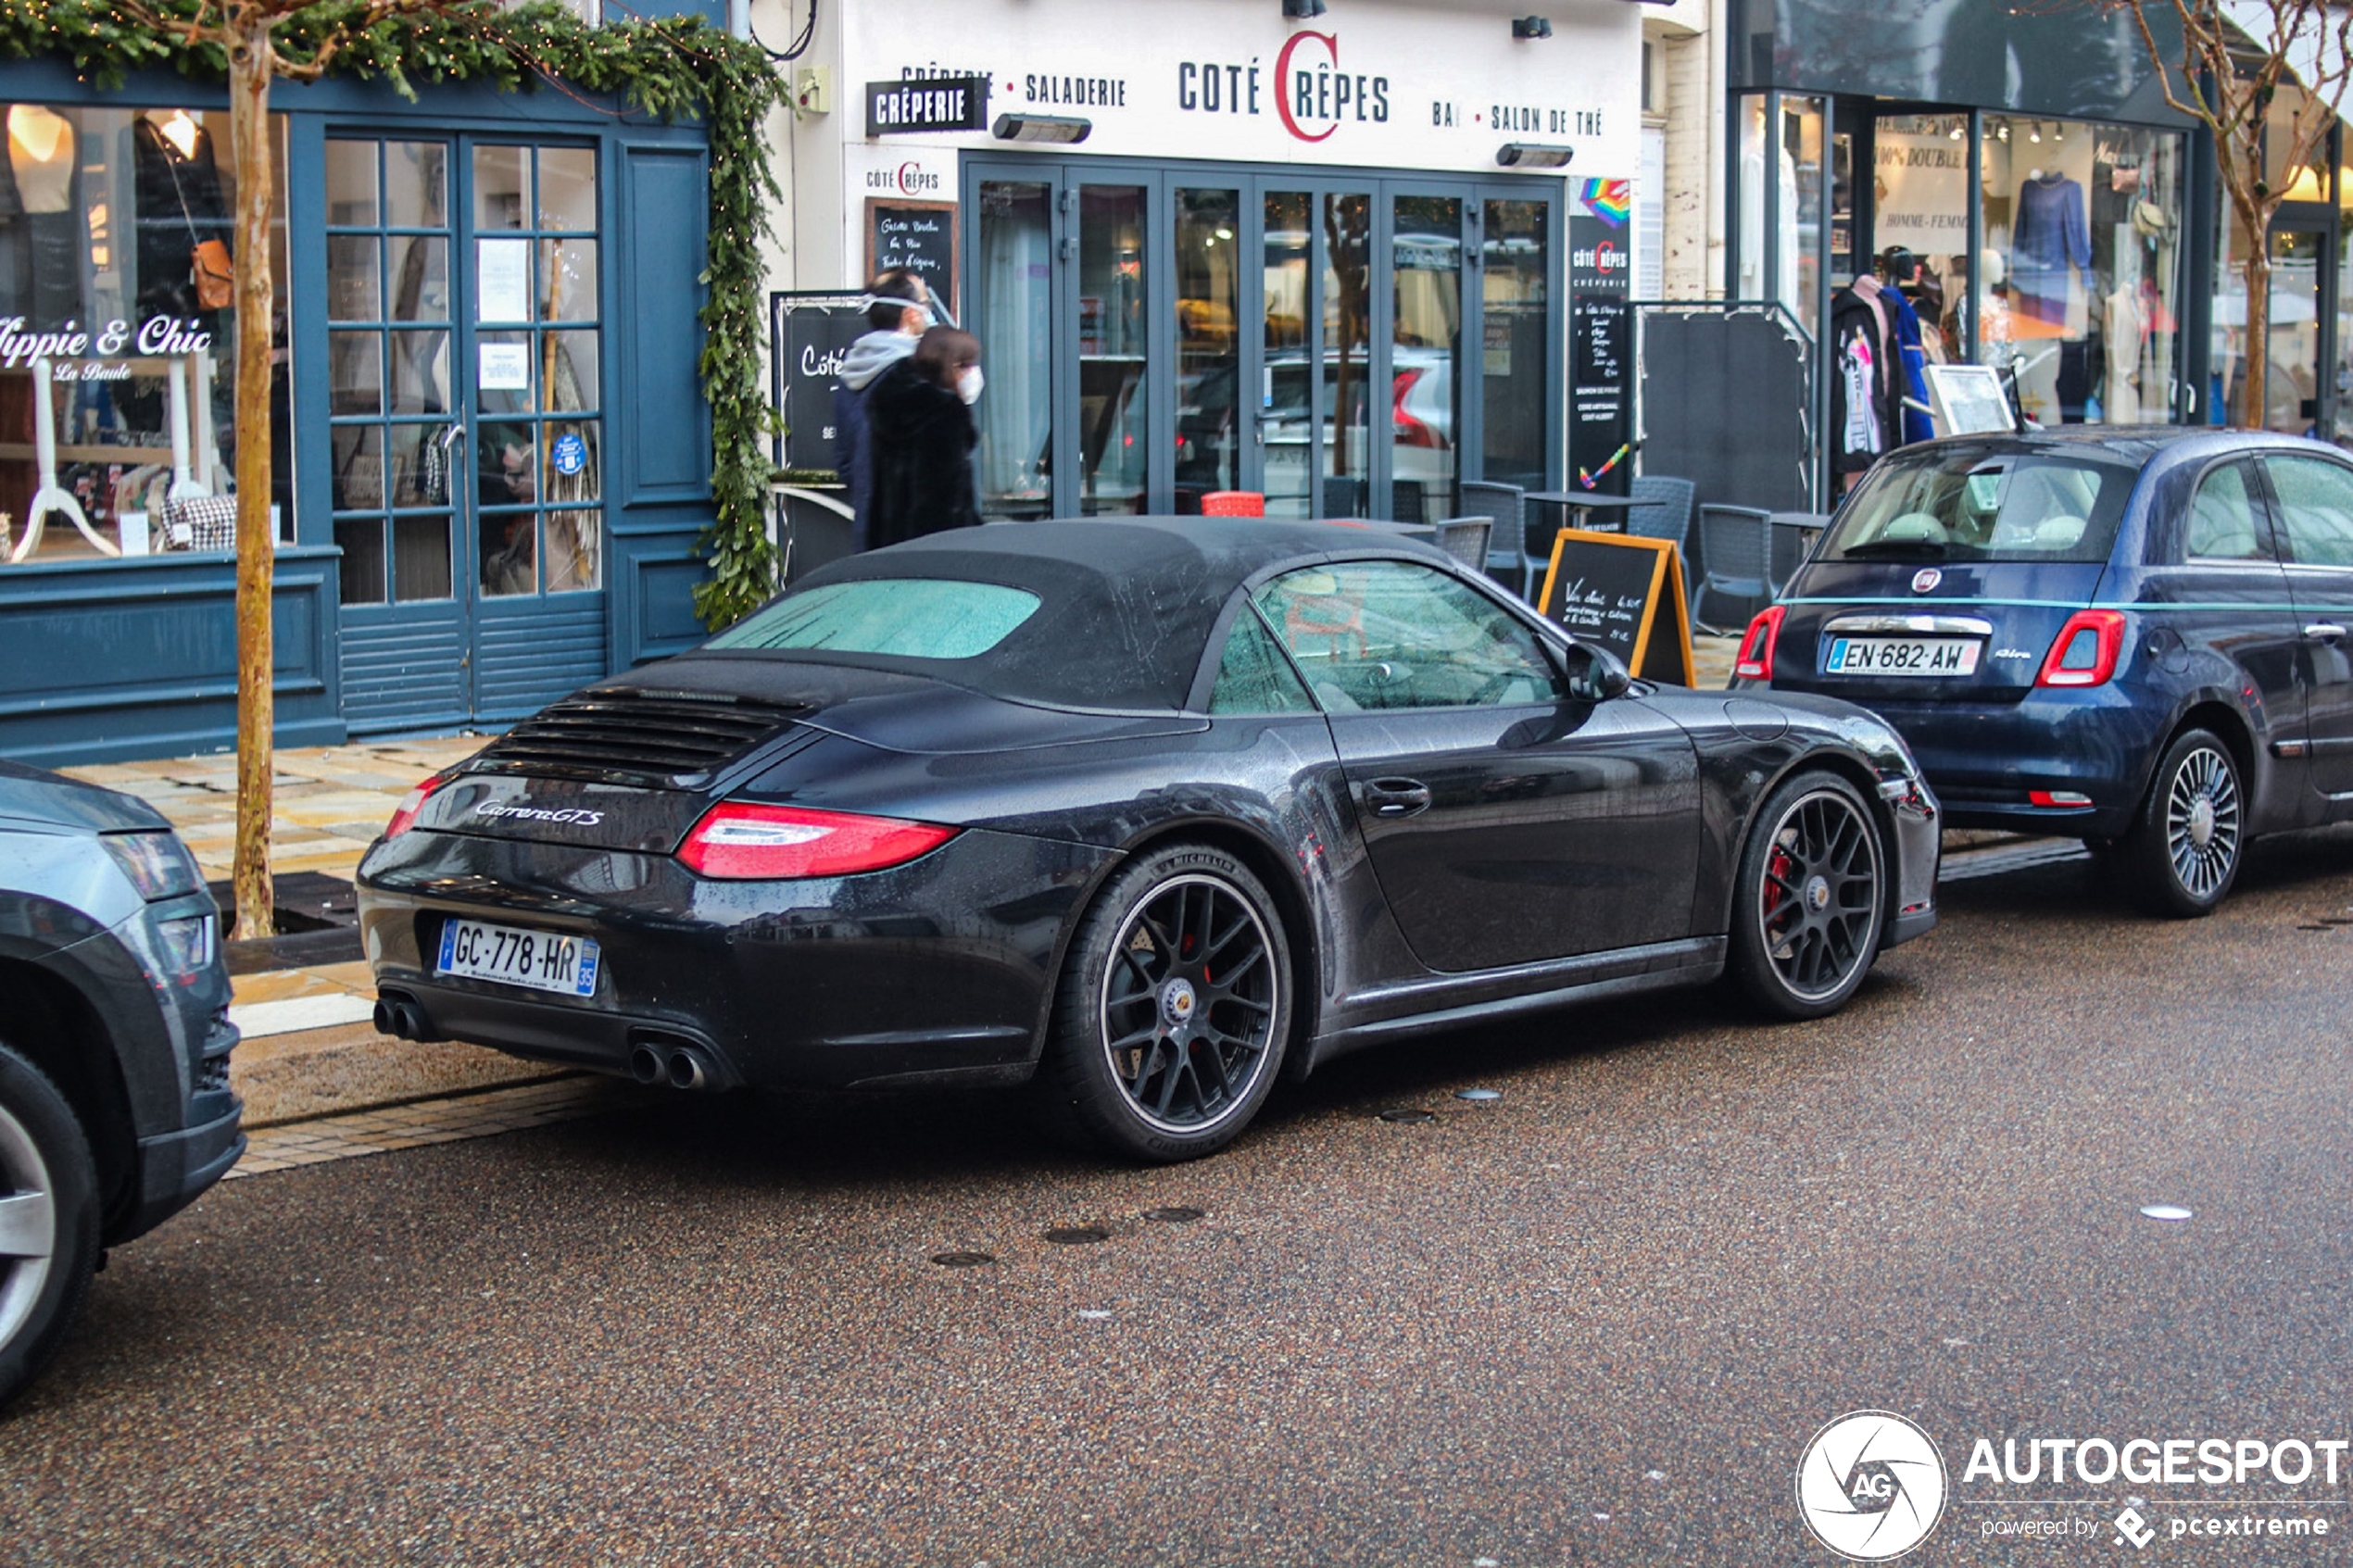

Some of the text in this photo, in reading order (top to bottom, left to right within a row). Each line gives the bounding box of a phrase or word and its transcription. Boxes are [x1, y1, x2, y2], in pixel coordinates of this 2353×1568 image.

[1026, 74, 1126, 107] SALADERIE
[1179, 30, 1389, 143] COTÉ CRÊPES
[876, 87, 965, 124] CRÊPERIE
[1432, 101, 1601, 136] BA SALON DE THÉ
[1907, 147, 1960, 169] DOUBLE
[866, 161, 939, 195] CÔTÉ CRÊPES
[1573, 240, 1628, 274] CÔTÉ CRÊPES
[96, 320, 130, 355] &
[138, 315, 212, 355] Chic
[53, 362, 78, 382] La
[822, 426, 837, 439] SE
[1844, 644, 1962, 669] EN-682-AW
[1173, 853, 1233, 872] MICHELIN
[456, 926, 575, 982] GC-778-HR
[578, 967, 593, 986] 35
